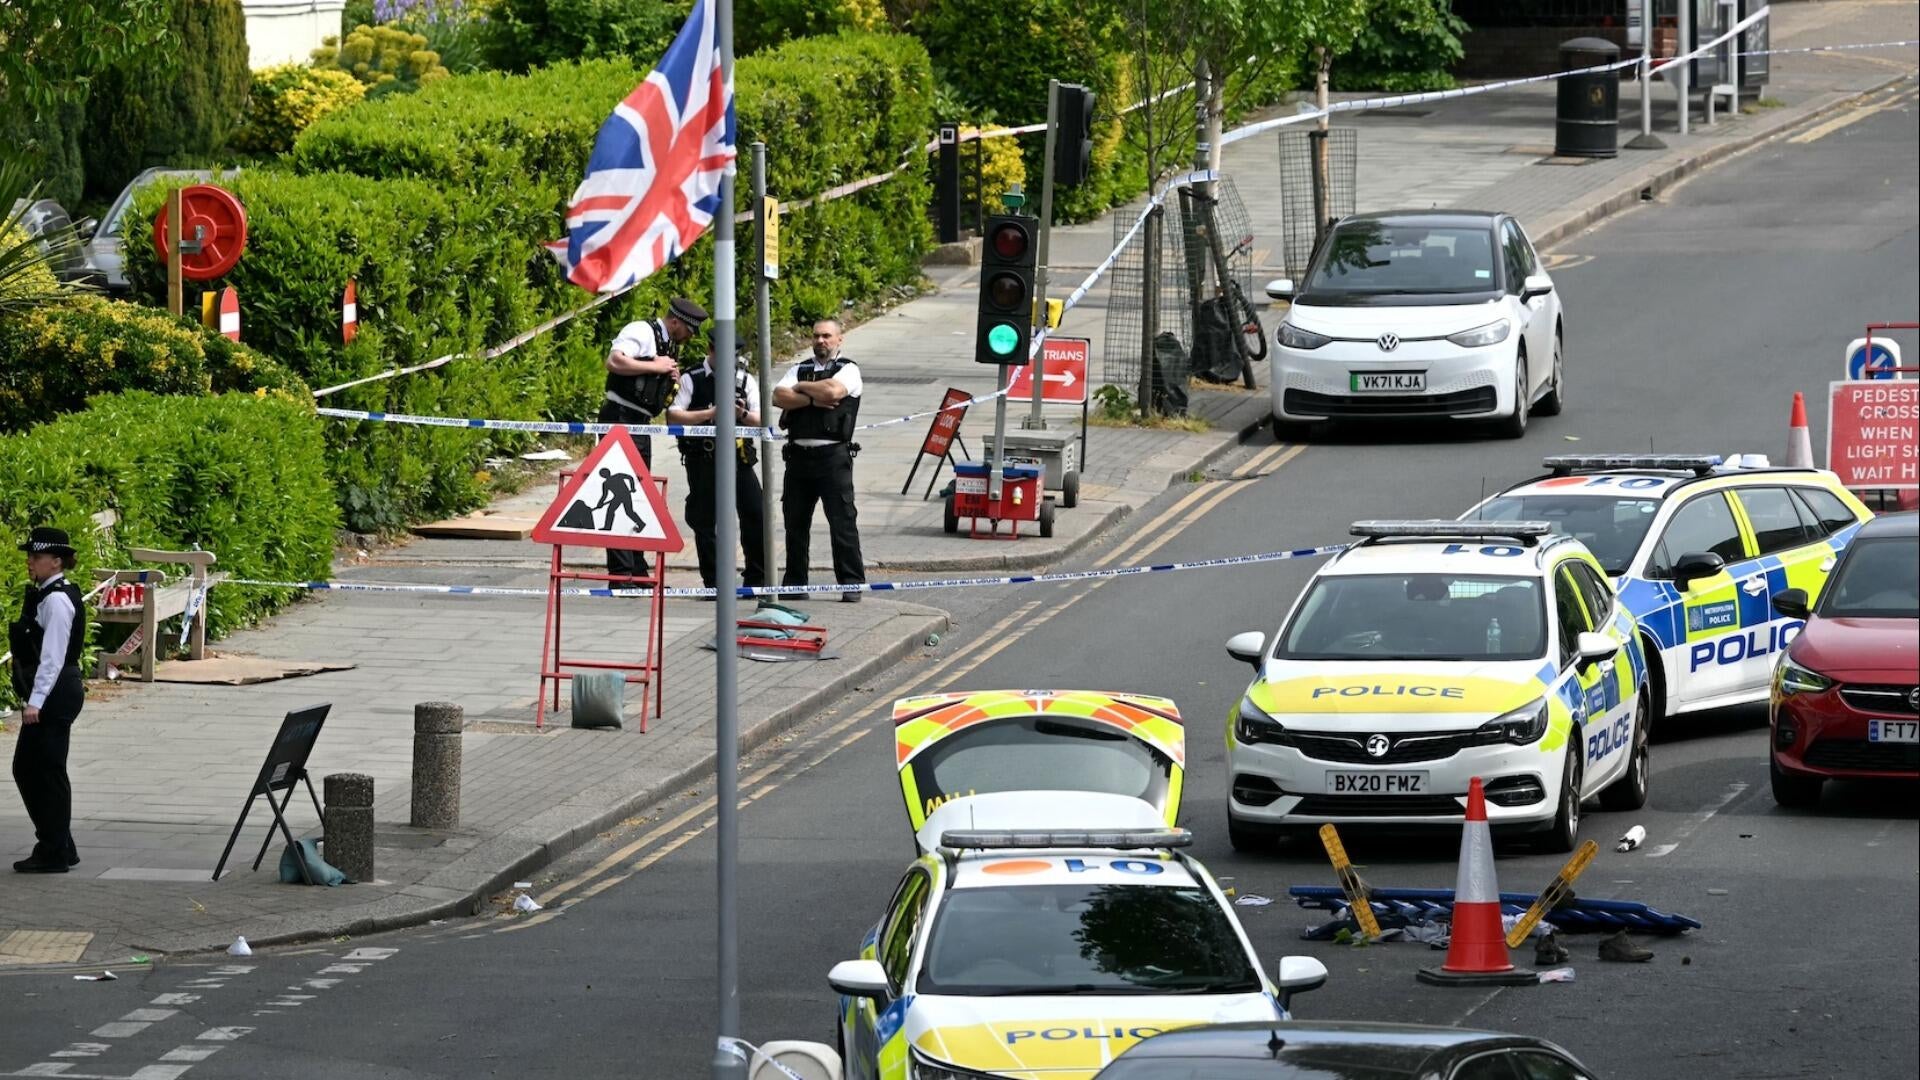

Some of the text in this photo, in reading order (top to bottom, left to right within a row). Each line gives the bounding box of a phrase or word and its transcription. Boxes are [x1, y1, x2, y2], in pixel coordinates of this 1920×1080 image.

[1044, 350, 1084, 361] TRIANS
[1363, 375, 1420, 388] VK71 KJA
[1853, 388, 1919, 403] PEDEST
[1860, 405, 1919, 419] CROSS
[1861, 426, 1913, 440] WHEN
[1847, 444, 1897, 458] LIGHT
[1852, 466, 1893, 480] WAIT
[1709, 614, 1731, 624] POLICE
[1691, 620, 1806, 673] POLIC
[1312, 685, 1465, 699] POLICE
[1884, 722, 1918, 739] FT7
[1587, 712, 1630, 767] POLICE
[1335, 775, 1420, 791] BX20 FMZ
[1006, 1027, 1162, 1044] POLIC
